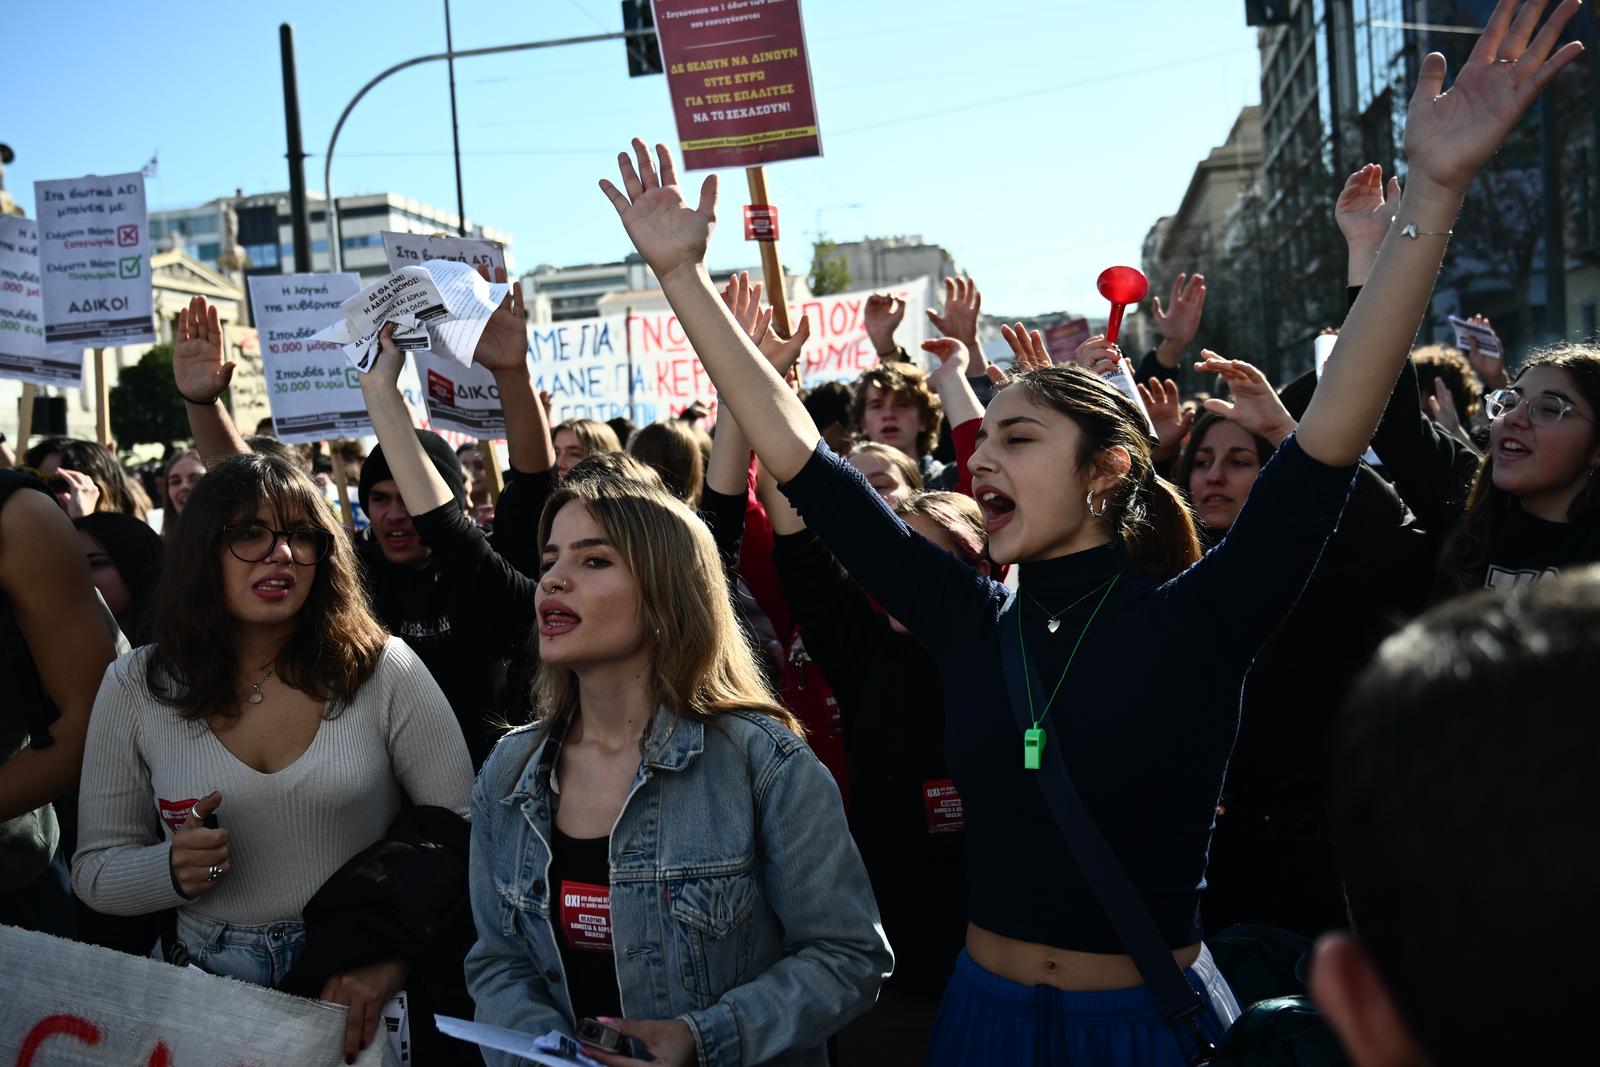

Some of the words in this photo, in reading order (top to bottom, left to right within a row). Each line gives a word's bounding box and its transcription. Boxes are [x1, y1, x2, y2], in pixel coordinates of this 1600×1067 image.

[671, 63, 685, 75] ΔΕ
[687, 57, 729, 73] ΘΕΛΟΥΝ
[731, 55, 749, 67] ΝΑ
[752, 48, 798, 64] ΔΙΝΟΥΝ
[704, 75, 732, 88] ΟΥΤΕ
[734, 71, 766, 84] ΕΥΡΩ
[685, 96, 704, 107] ΓΙΑ
[705, 93, 733, 104] ΤΟΥΣ
[734, 84, 796, 101] ΕΠΑΛΙΤΕΣ
[692, 113, 709, 123] ΝΑ
[711, 110, 725, 121] ΤΟ
[726, 102, 792, 119] ΞΕΧΑΣΟΥΝ!
[44, 190, 65, 201] Στα
[117, 184, 138, 195] ΑΕΙ
[396, 246, 419, 260] Στα
[281, 286, 290, 296] Η
[363, 306, 371, 315] Η
[371, 294, 393, 311] ΑΔΙΚΙΑ
[393, 276, 420, 295] ΝΟΜΟΣ!
[368, 291, 378, 302] ΔΕ
[378, 285, 390, 295] ΘΑ
[389, 274, 406, 287] ΓΙΝΕΙ
[68, 296, 129, 314] ΑΔΙΚΟ!
[396, 298, 407, 307] ΚΑΙ
[268, 342, 303, 354] 10.000
[580, 322, 614, 358] ΓΙΑ
[275, 366, 325, 380] Σπουδές
[328, 367, 343, 378] με
[657, 358, 718, 398] ΚΕΡ
[274, 381, 311, 394] 30.000
[565, 894, 580, 907] ΟΧΙ
